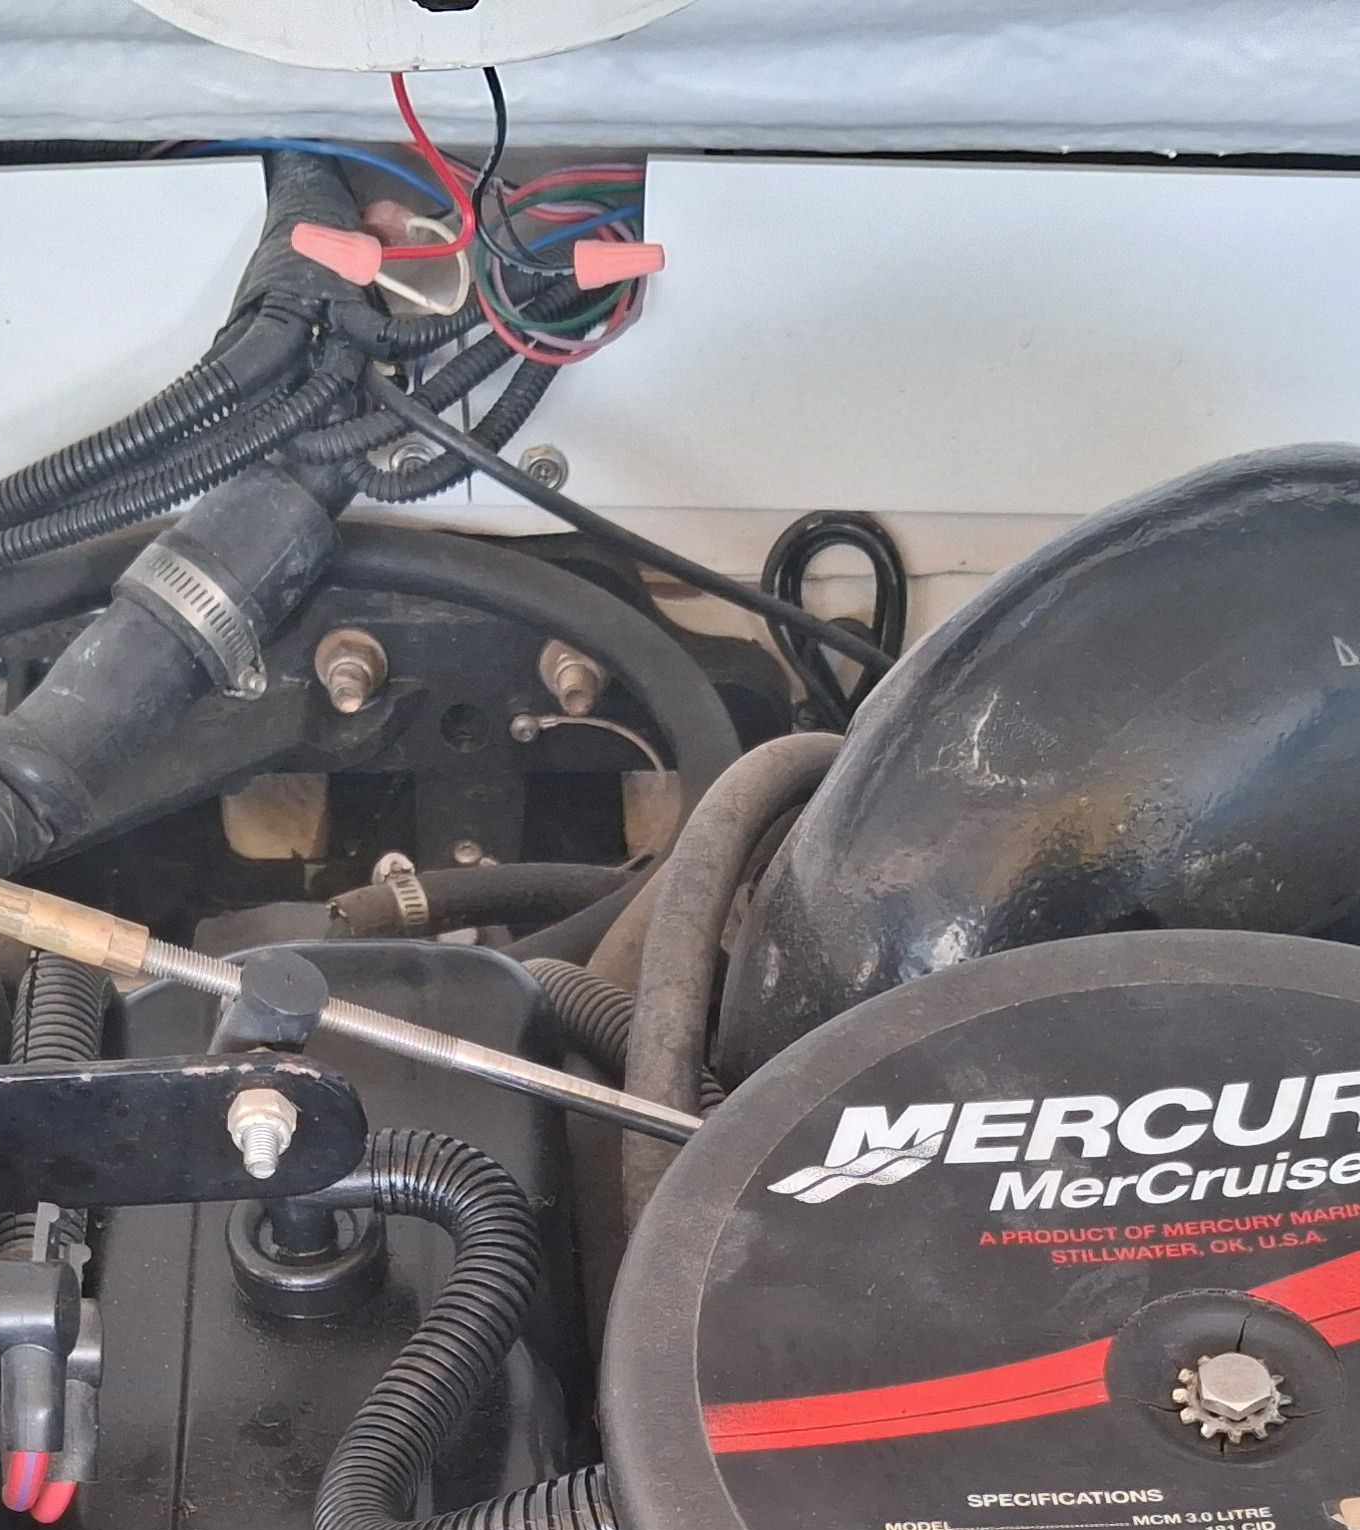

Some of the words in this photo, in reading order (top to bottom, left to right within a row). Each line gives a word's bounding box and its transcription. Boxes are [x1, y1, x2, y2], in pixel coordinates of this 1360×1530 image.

[979, 1230, 997, 1247] A
[1001, 1227, 1116, 1246] PRODUCT
[1128, 1224, 1156, 1240] OF
[1162, 1213, 1282, 1238] MERCURY
[1050, 1241, 1205, 1265] STILLWATER,
[1210, 1236, 1253, 1255] OK,
[1259, 1229, 1327, 1250] U.S.A.
[967, 1489, 1164, 1508] SPECIFICATIONS
[1132, 1513, 1183, 1526] MCM
[1185, 1511, 1213, 1523] 3.0
[1217, 1507, 1273, 1521] LITRE
